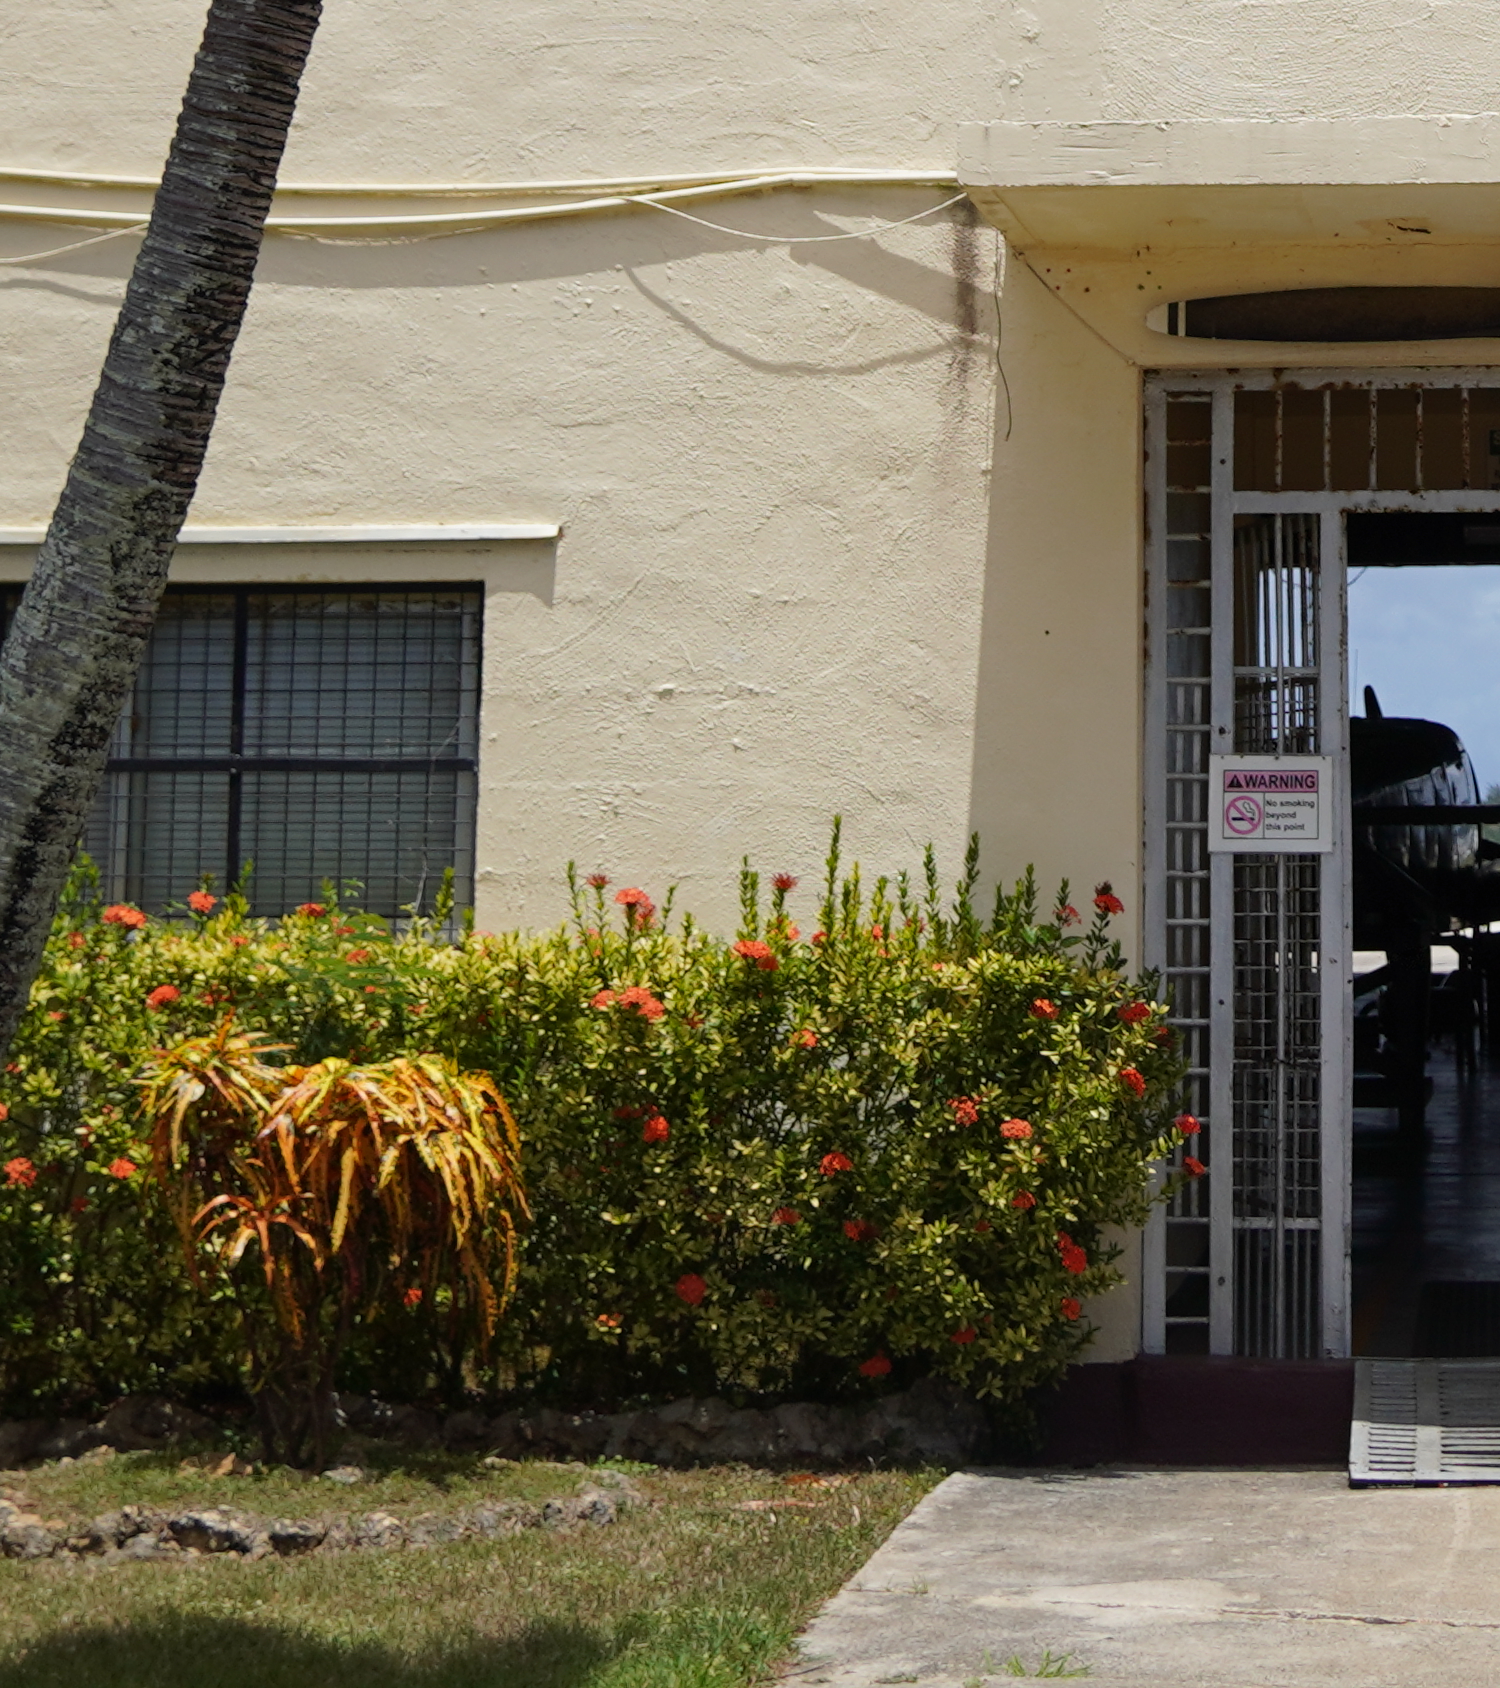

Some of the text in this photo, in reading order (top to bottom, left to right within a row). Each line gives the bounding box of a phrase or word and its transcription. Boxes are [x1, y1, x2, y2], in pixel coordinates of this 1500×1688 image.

[1244, 774, 1316, 789] WARNING
[1266, 799, 1315, 809] No smoking
[1266, 811, 1297, 820] beyond
[1266, 823, 1305, 832] this point
